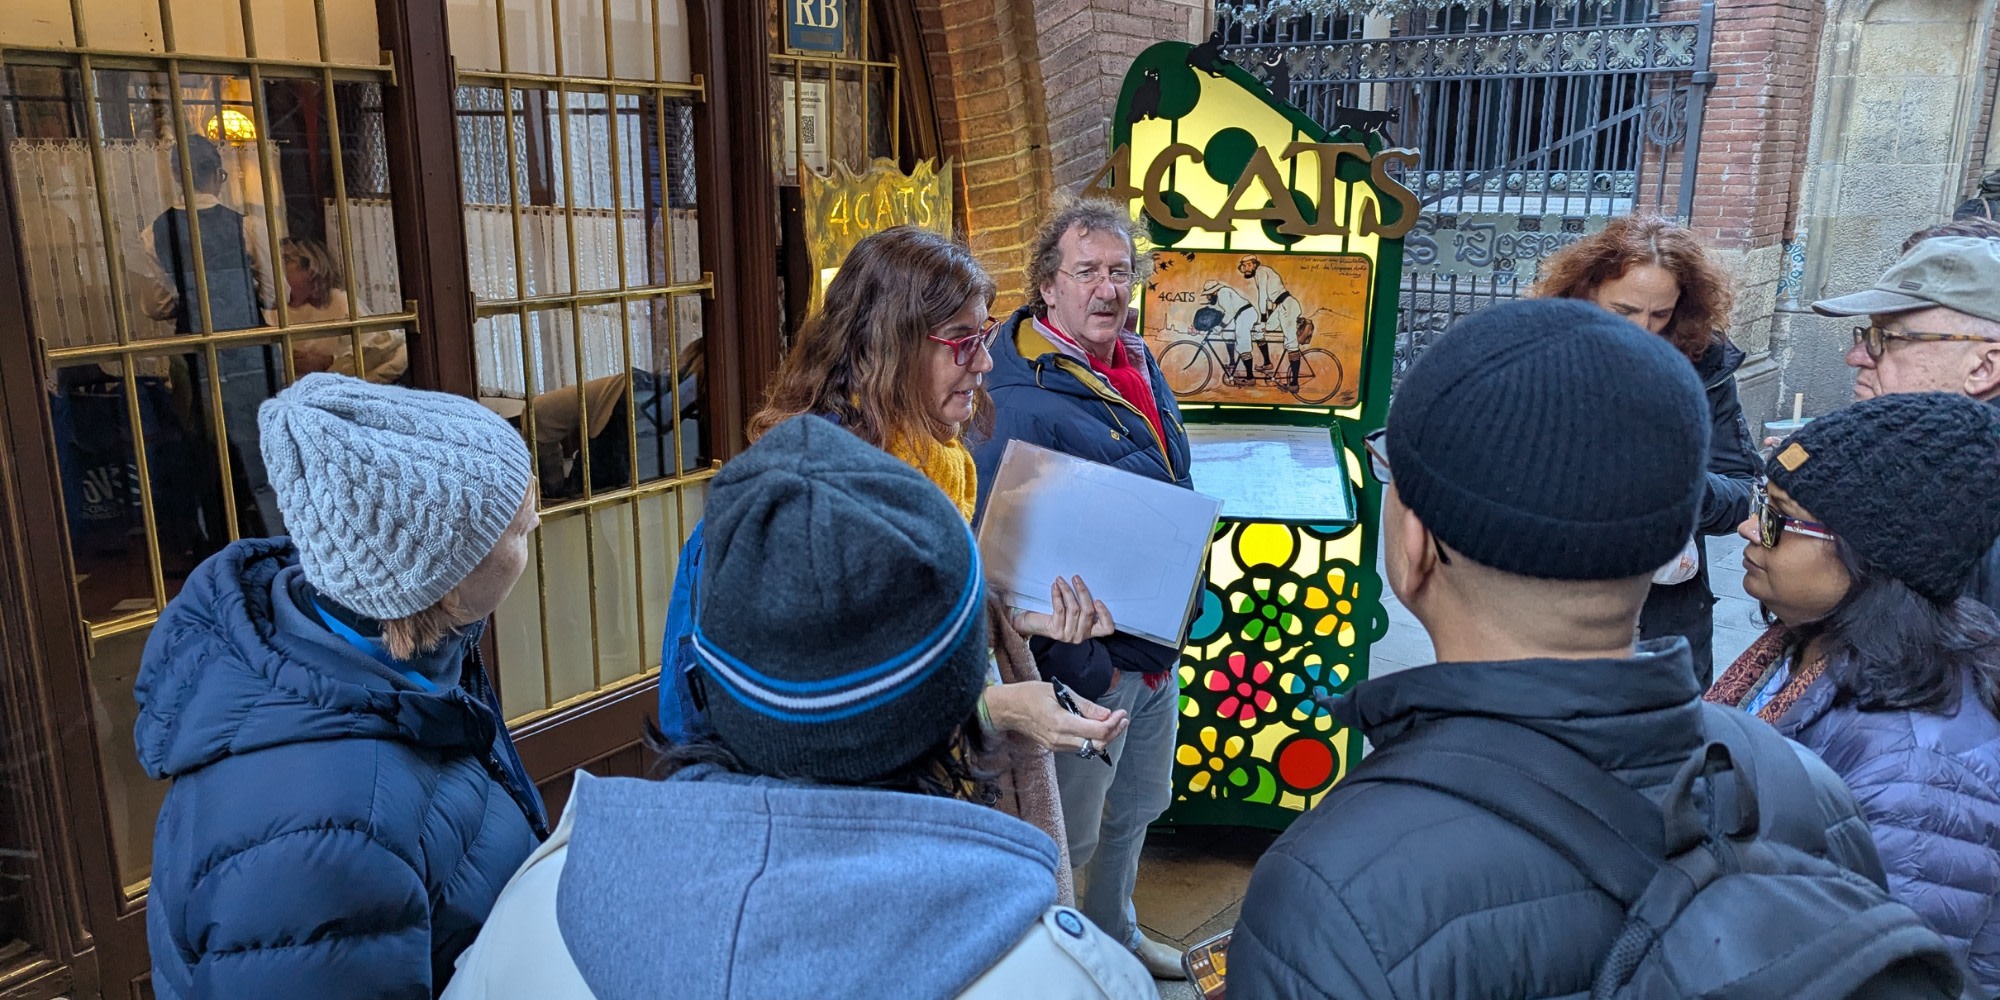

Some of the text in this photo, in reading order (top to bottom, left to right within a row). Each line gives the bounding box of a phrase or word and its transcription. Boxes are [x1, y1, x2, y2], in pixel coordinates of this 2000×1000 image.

[794, 0, 839, 29] RB
[829, 183, 931, 235] 4CATS
[1081, 141, 1421, 239] 4CATS
[1158, 291, 1196, 303] 4CATS
